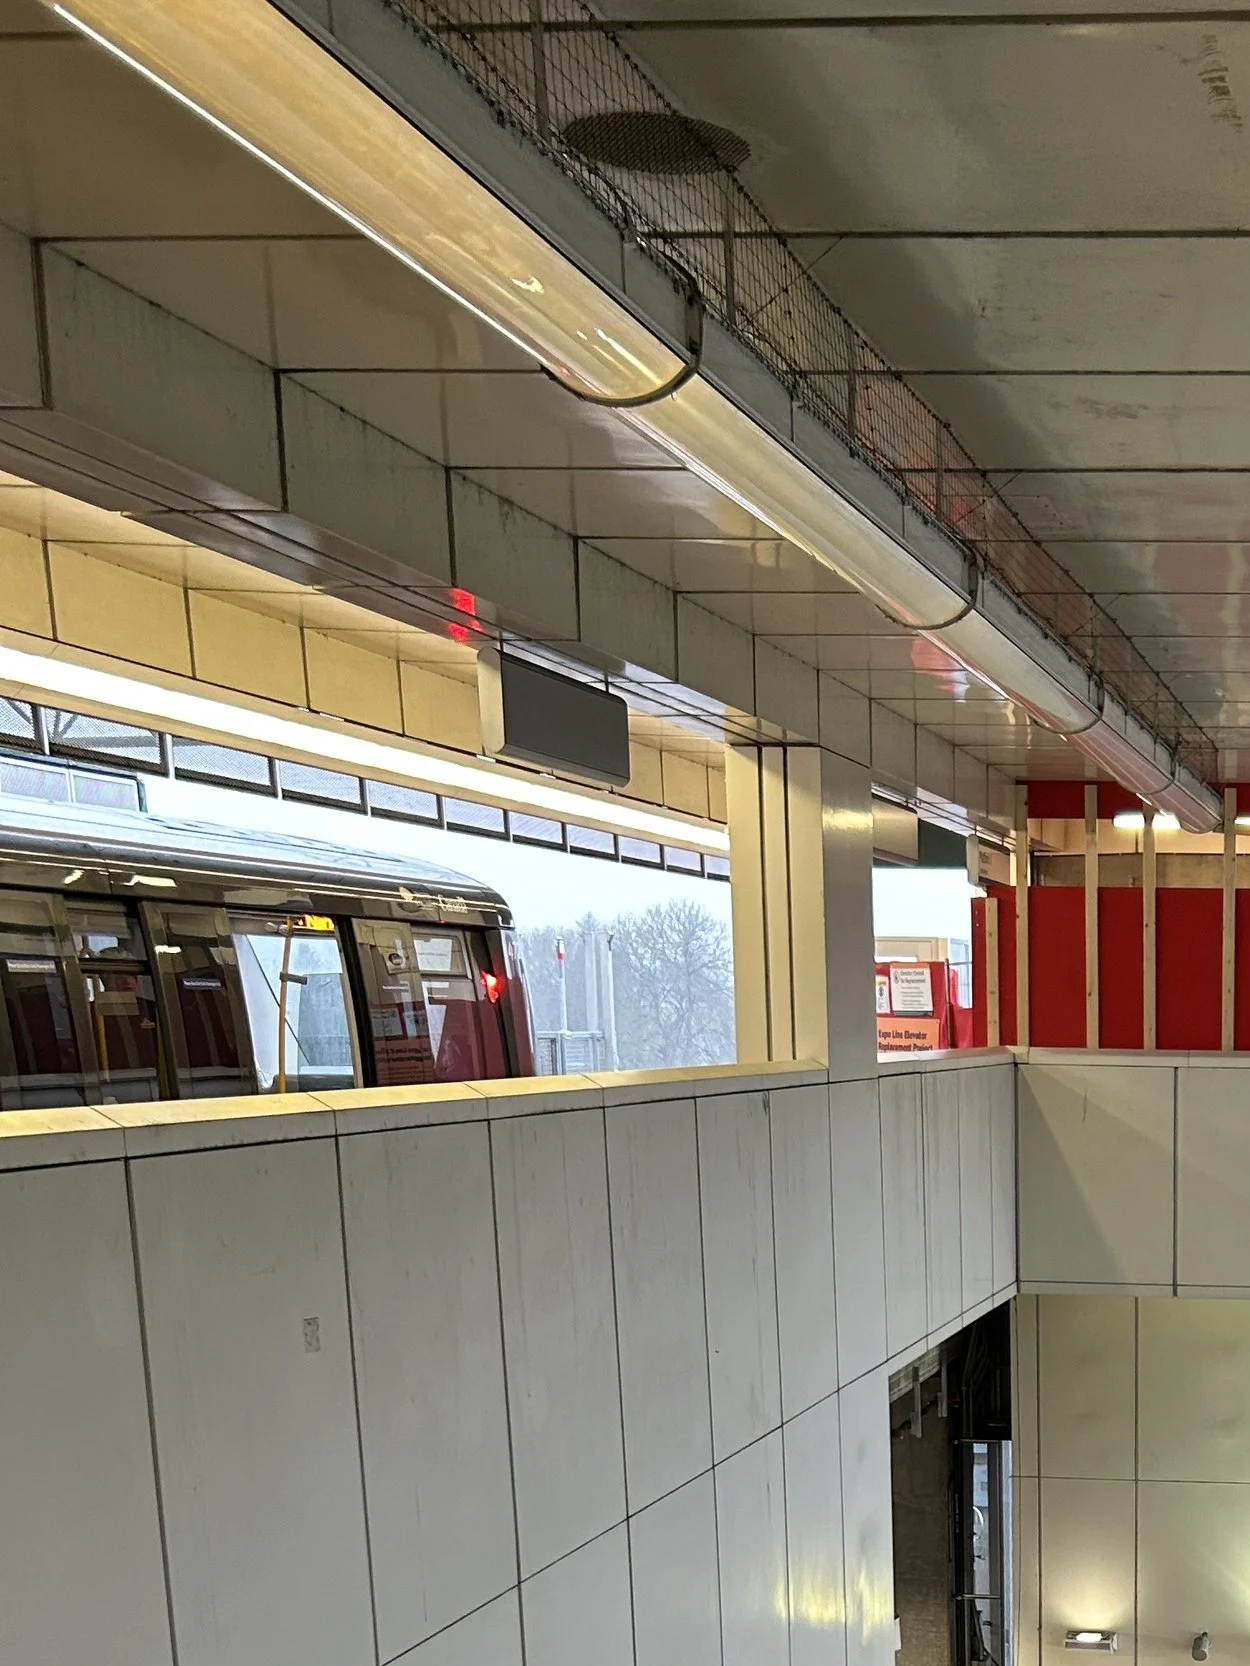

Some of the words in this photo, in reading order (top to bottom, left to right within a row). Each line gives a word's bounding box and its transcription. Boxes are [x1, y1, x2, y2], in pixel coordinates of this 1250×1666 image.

[878, 1028, 892, 1041] Expo
[892, 1029, 903, 1040] Line
[904, 1030, 928, 1040] Elevator
